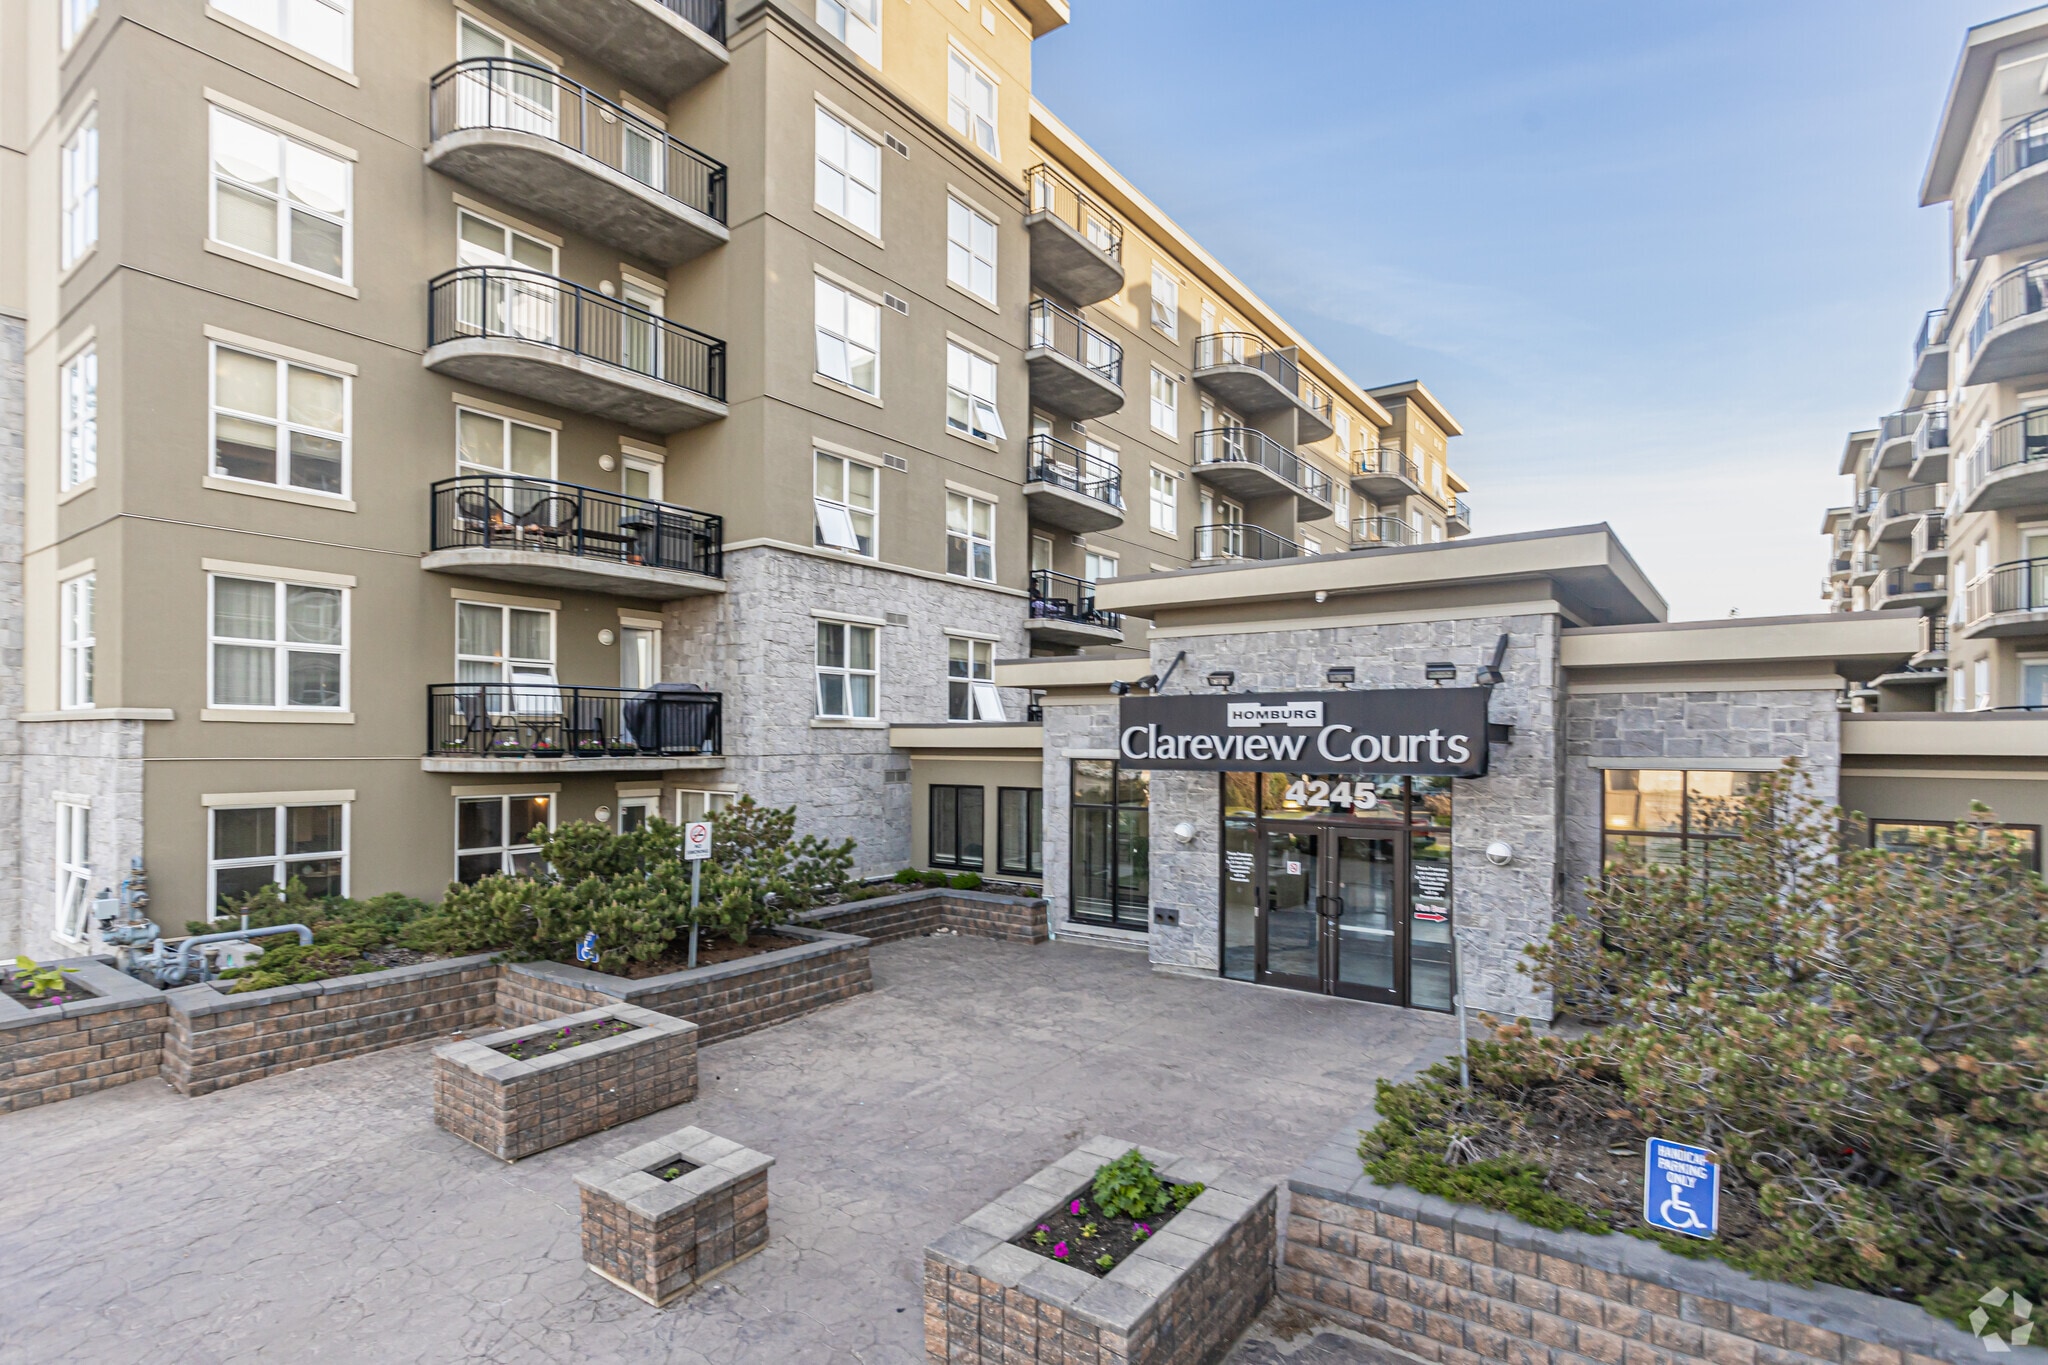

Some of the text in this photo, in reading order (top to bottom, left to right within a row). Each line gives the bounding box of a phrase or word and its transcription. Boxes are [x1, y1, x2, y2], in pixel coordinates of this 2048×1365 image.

[1232, 710, 1317, 720] HOMBURG
[1120, 723, 1471, 764] Clareview Courts
[1285, 780, 1377, 809] 4245
[1658, 1157, 1708, 1179] PARKING
[1666, 1171, 1697, 1188] ONLY
